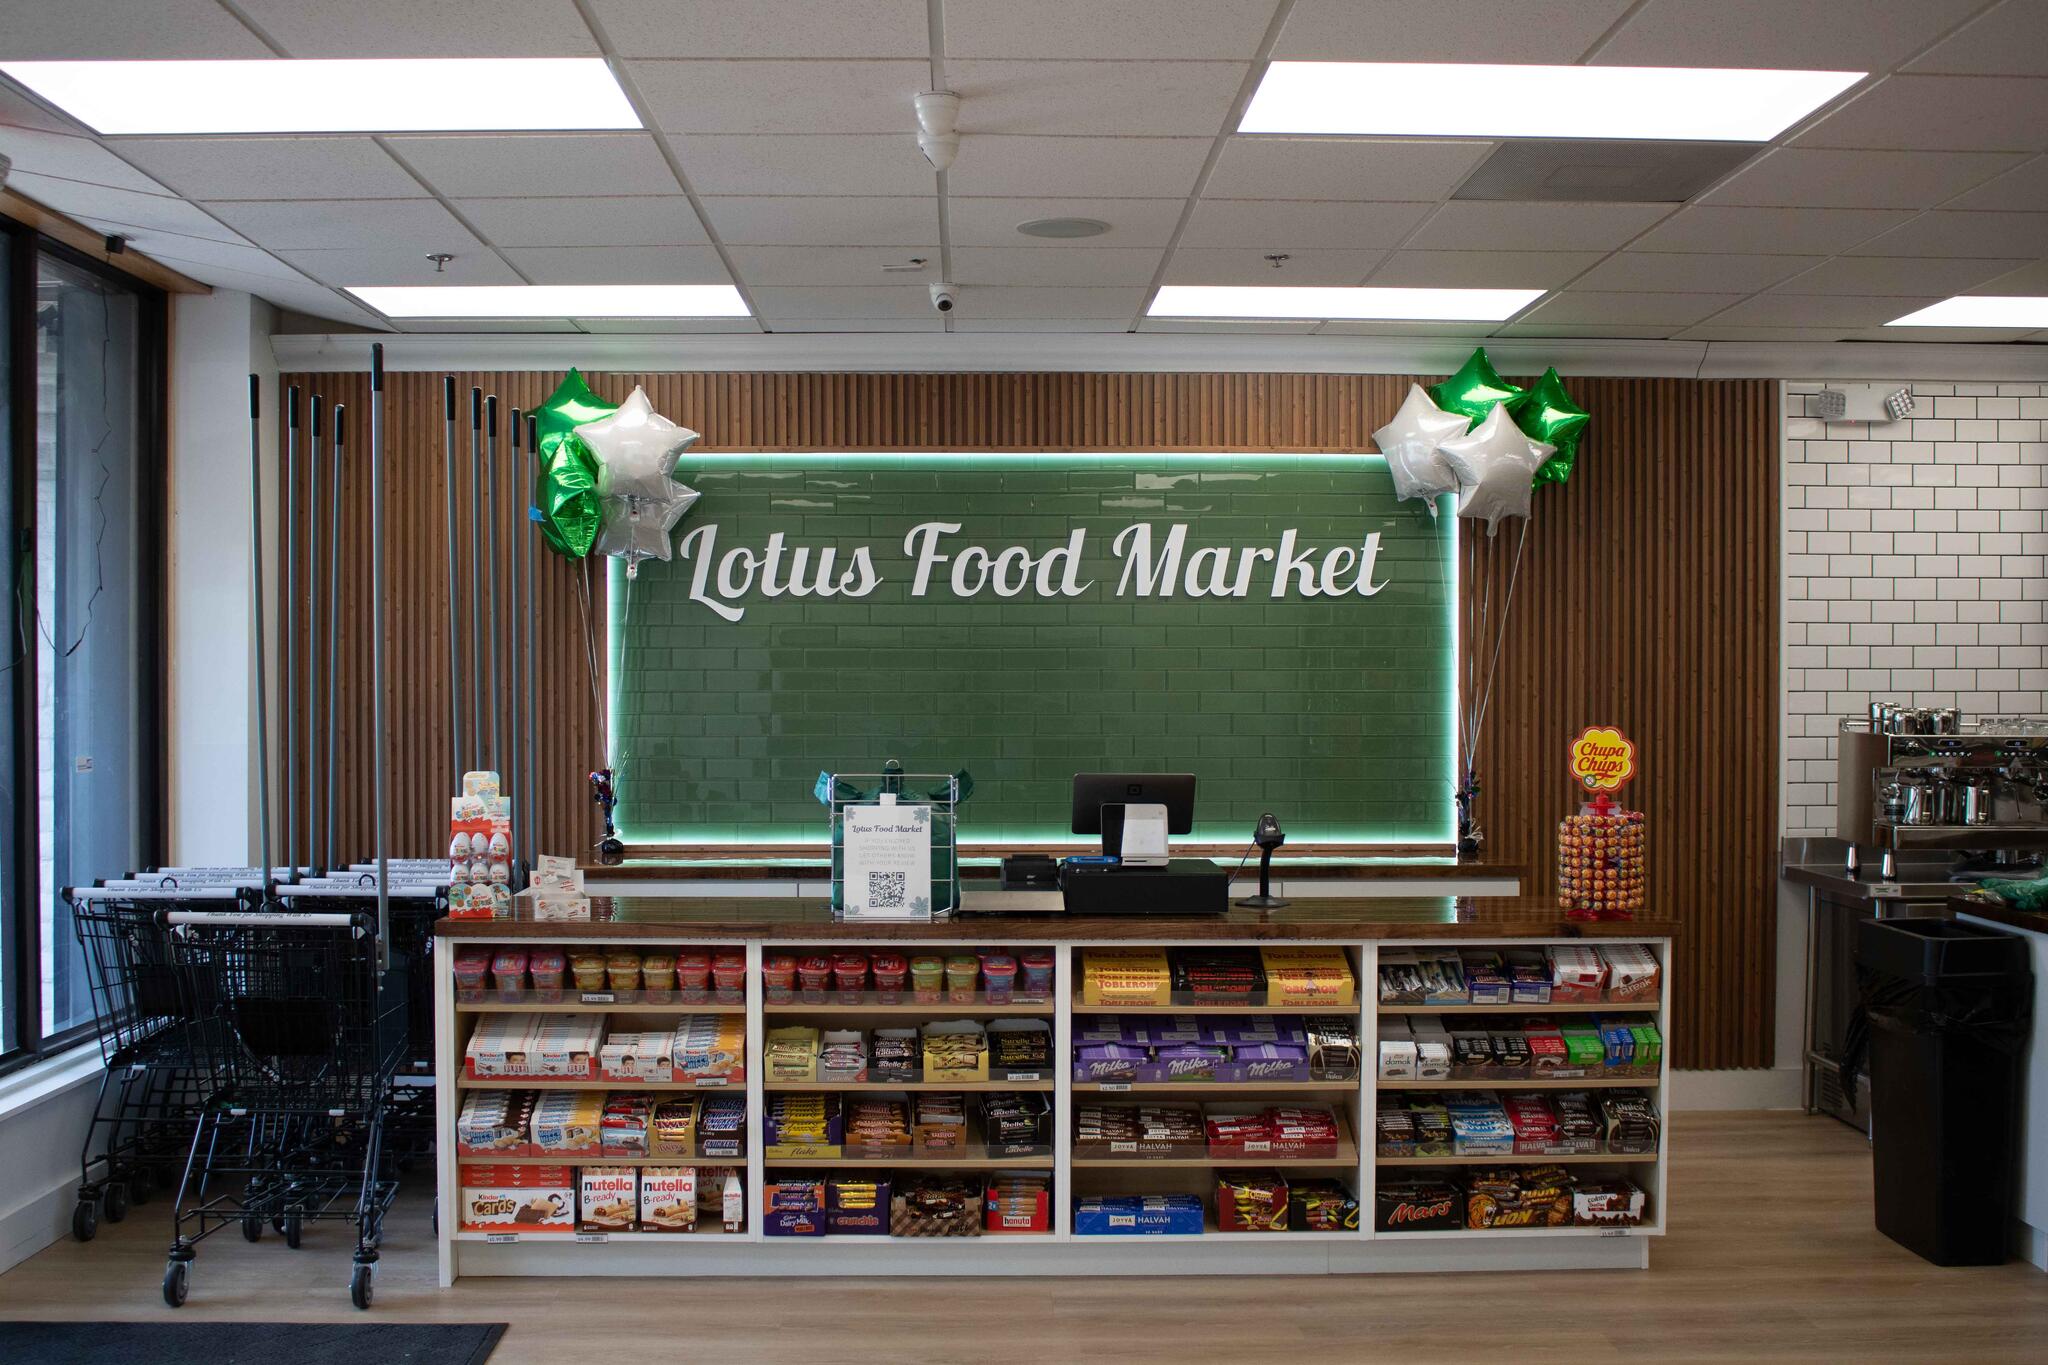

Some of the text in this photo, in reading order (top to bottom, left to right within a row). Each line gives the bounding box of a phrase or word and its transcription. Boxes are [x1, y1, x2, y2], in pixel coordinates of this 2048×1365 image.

[680, 522, 1390, 622] Lotus Food Market
[1580, 742, 1626, 761] Chupa
[1577, 756, 1624, 774] Chups
[852, 825, 923, 833] Lotus Food Market
[1089, 1060, 1131, 1075] Milka
[1168, 1057, 1209, 1074] Milka
[1247, 1060, 1294, 1076] Milka
[704, 1140, 738, 1149] SNICKERS
[584, 1178, 633, 1192] nutella
[644, 1178, 693, 1192] nutella
[584, 1192, 617, 1205] B-ready
[643, 1192, 676, 1205] B-ready
[473, 1200, 516, 1216] Cards
[1388, 1201, 1452, 1225] Mars
[780, 1216, 812, 1227] Dairy Milk
[1004, 1216, 1030, 1225] hanuta
[1493, 1209, 1533, 1226] LION
